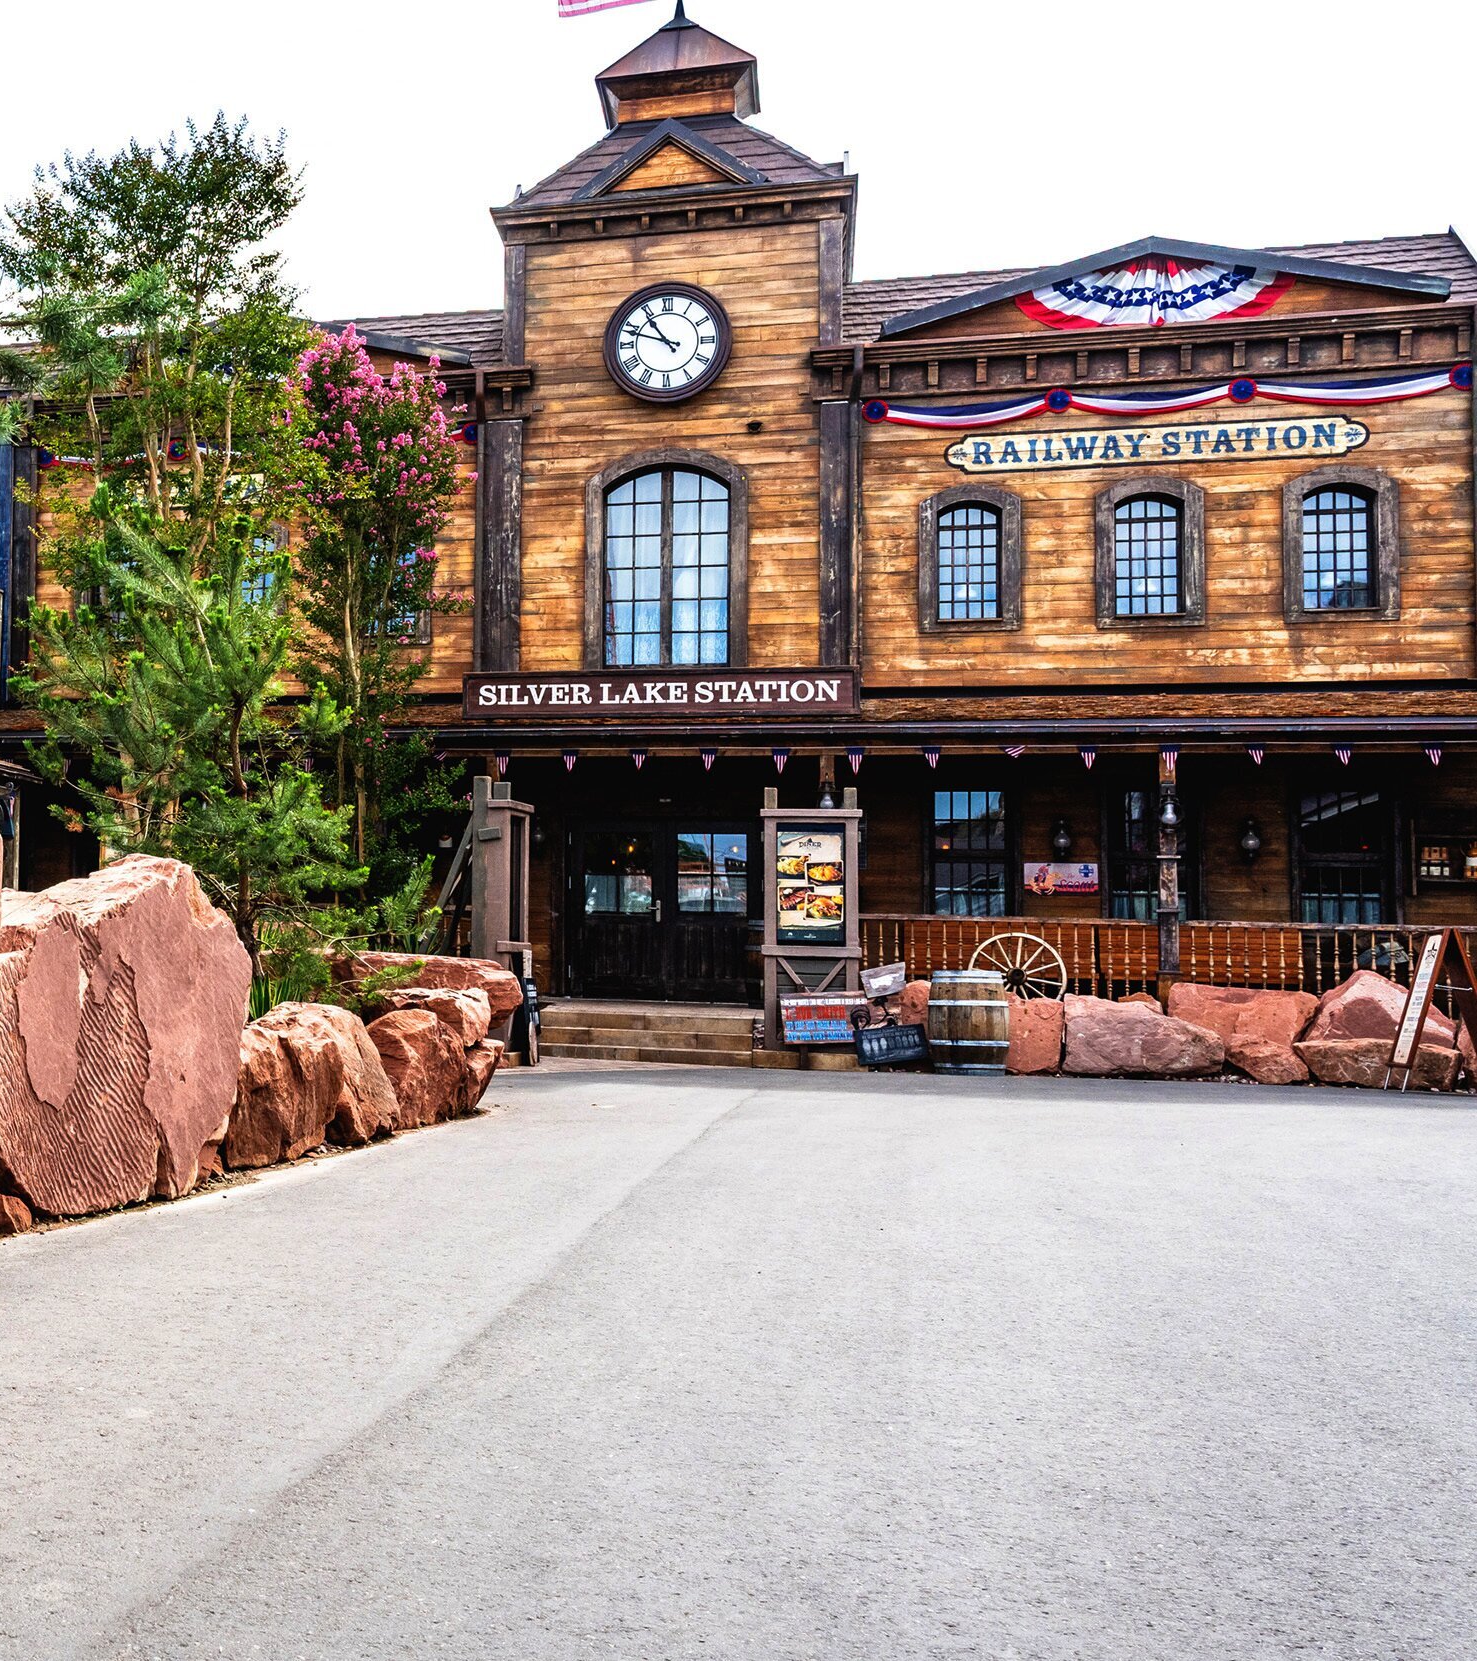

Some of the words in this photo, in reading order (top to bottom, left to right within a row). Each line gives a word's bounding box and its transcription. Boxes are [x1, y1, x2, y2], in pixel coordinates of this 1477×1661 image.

[971, 434, 1147, 466] RAILWAY
[1161, 422, 1337, 457] STATION
[478, 684, 593, 706] SILVER
[599, 682, 688, 705] LAKE
[694, 679, 842, 704] STATION
